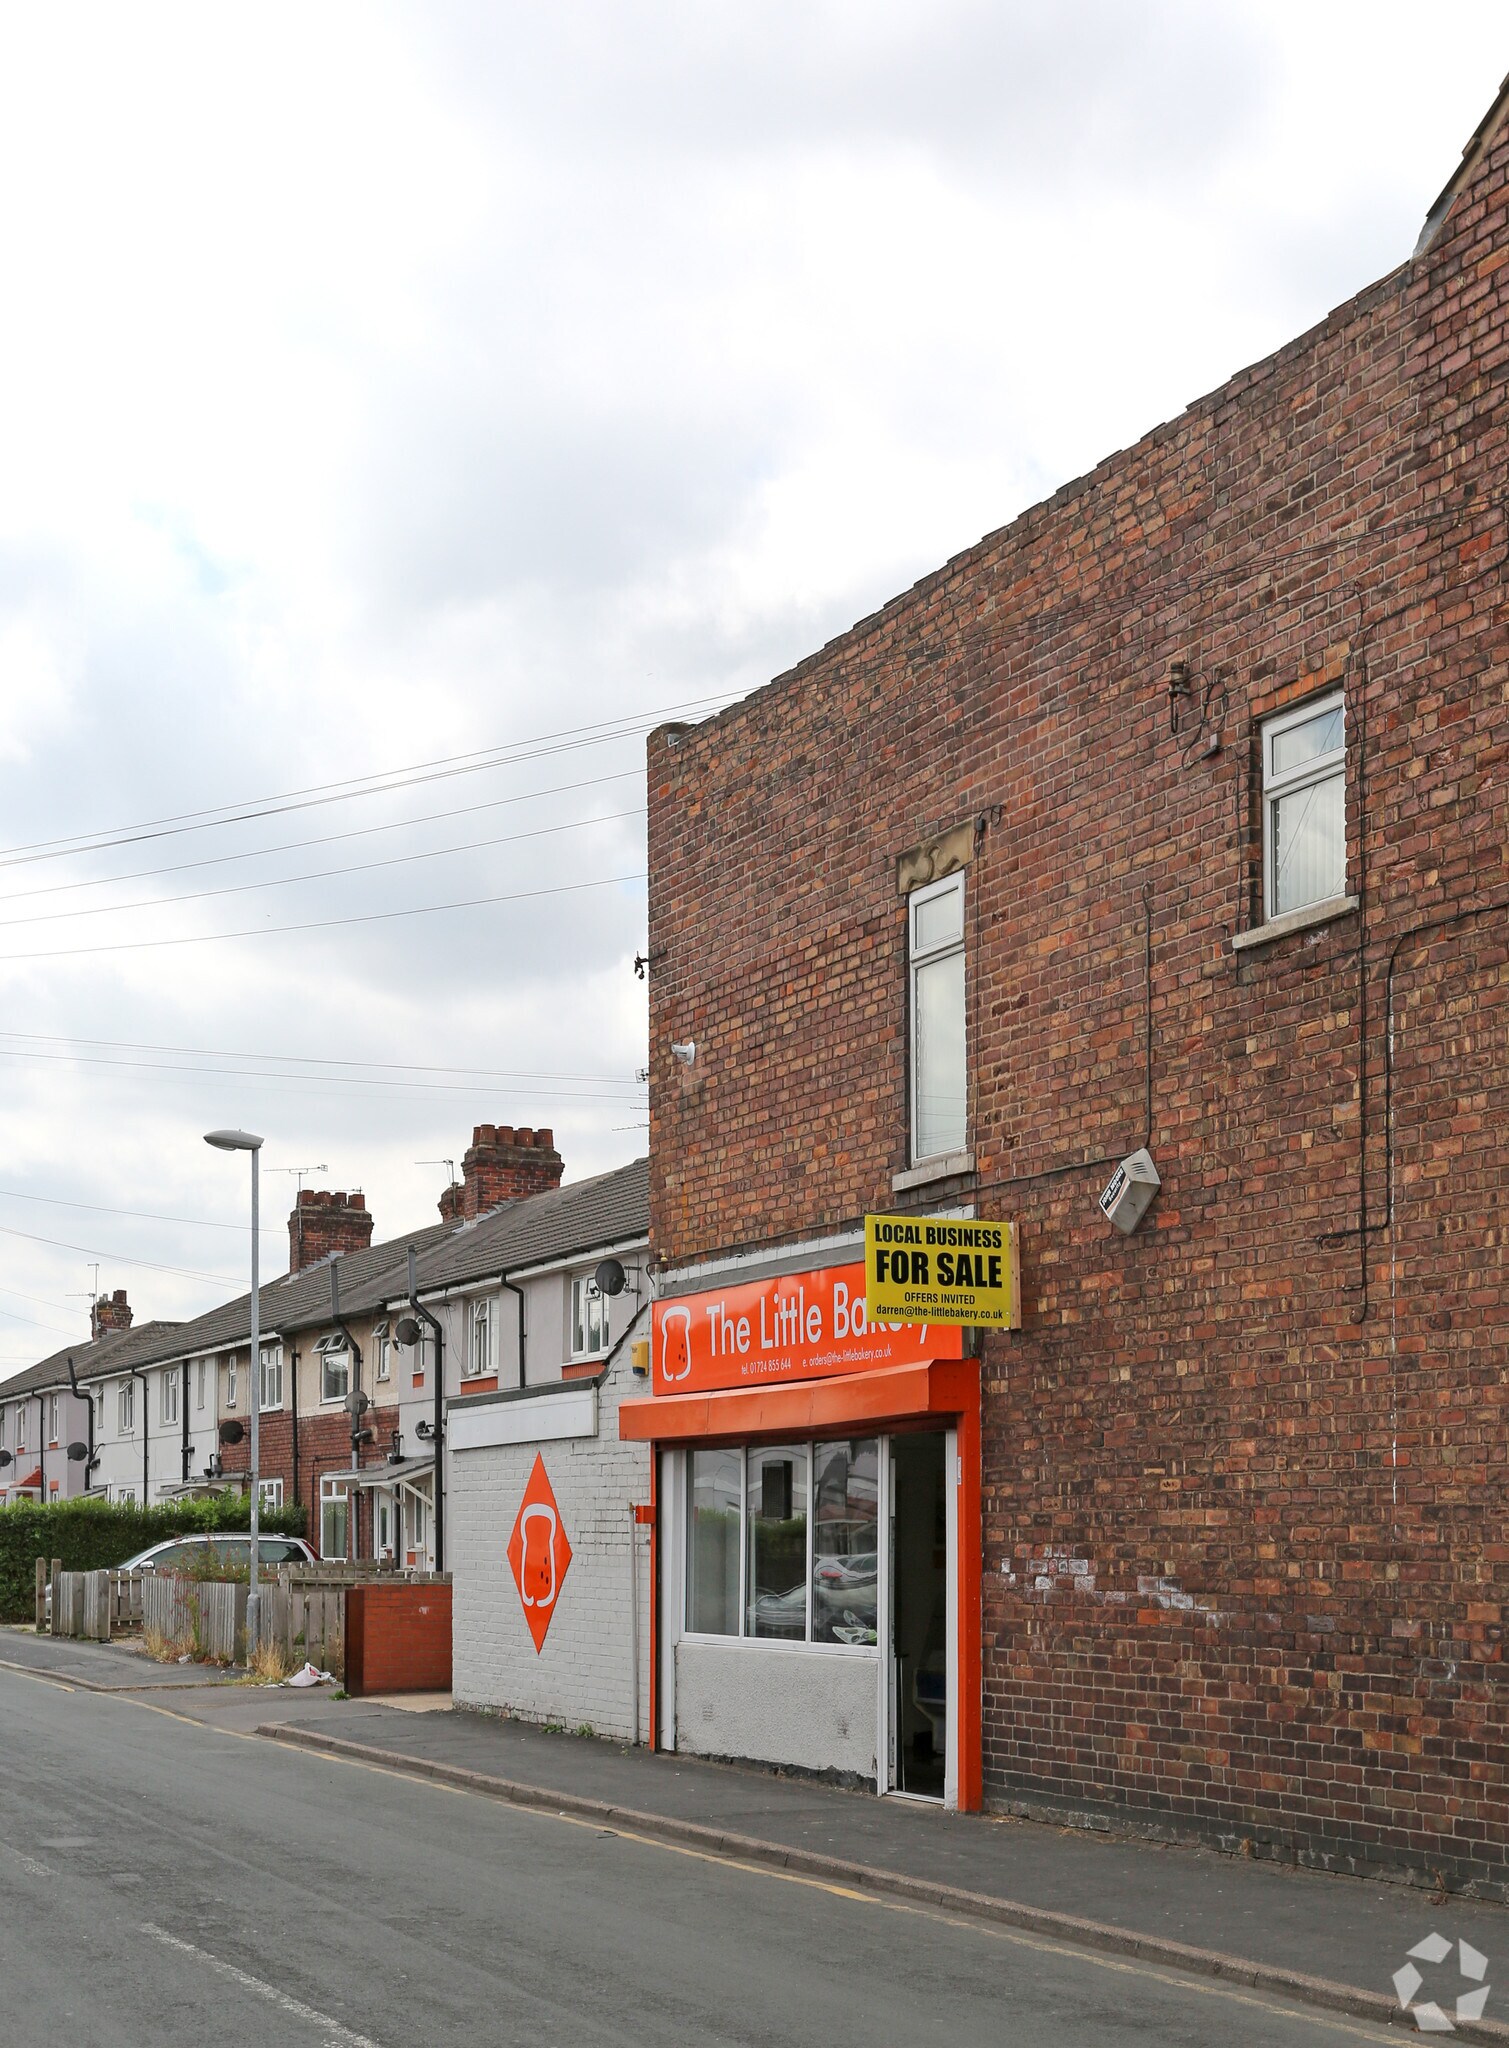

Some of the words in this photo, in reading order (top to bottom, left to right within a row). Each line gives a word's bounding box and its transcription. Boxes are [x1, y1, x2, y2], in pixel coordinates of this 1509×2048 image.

[875, 1223, 922, 1244] LOCAL
[926, 1226, 1002, 1249] BUSINESS
[876, 1249, 929, 1285] FOR
[937, 1252, 1002, 1288] SALE
[876, 1304, 1003, 1320] darren@the-littlebakery.co.uk
[904, 1292, 938, 1304] OFFERS
[941, 1293, 975, 1305] INVITED
[706, 1301, 750, 1356] The
[760, 1286, 822, 1349] Little
[750, 1360, 767, 1374] 01724
[768, 1358, 779, 1372] 855
[781, 1357, 791, 1370] 644
[809, 1344, 892, 1368] orders@the-littlebakery.co.uk
